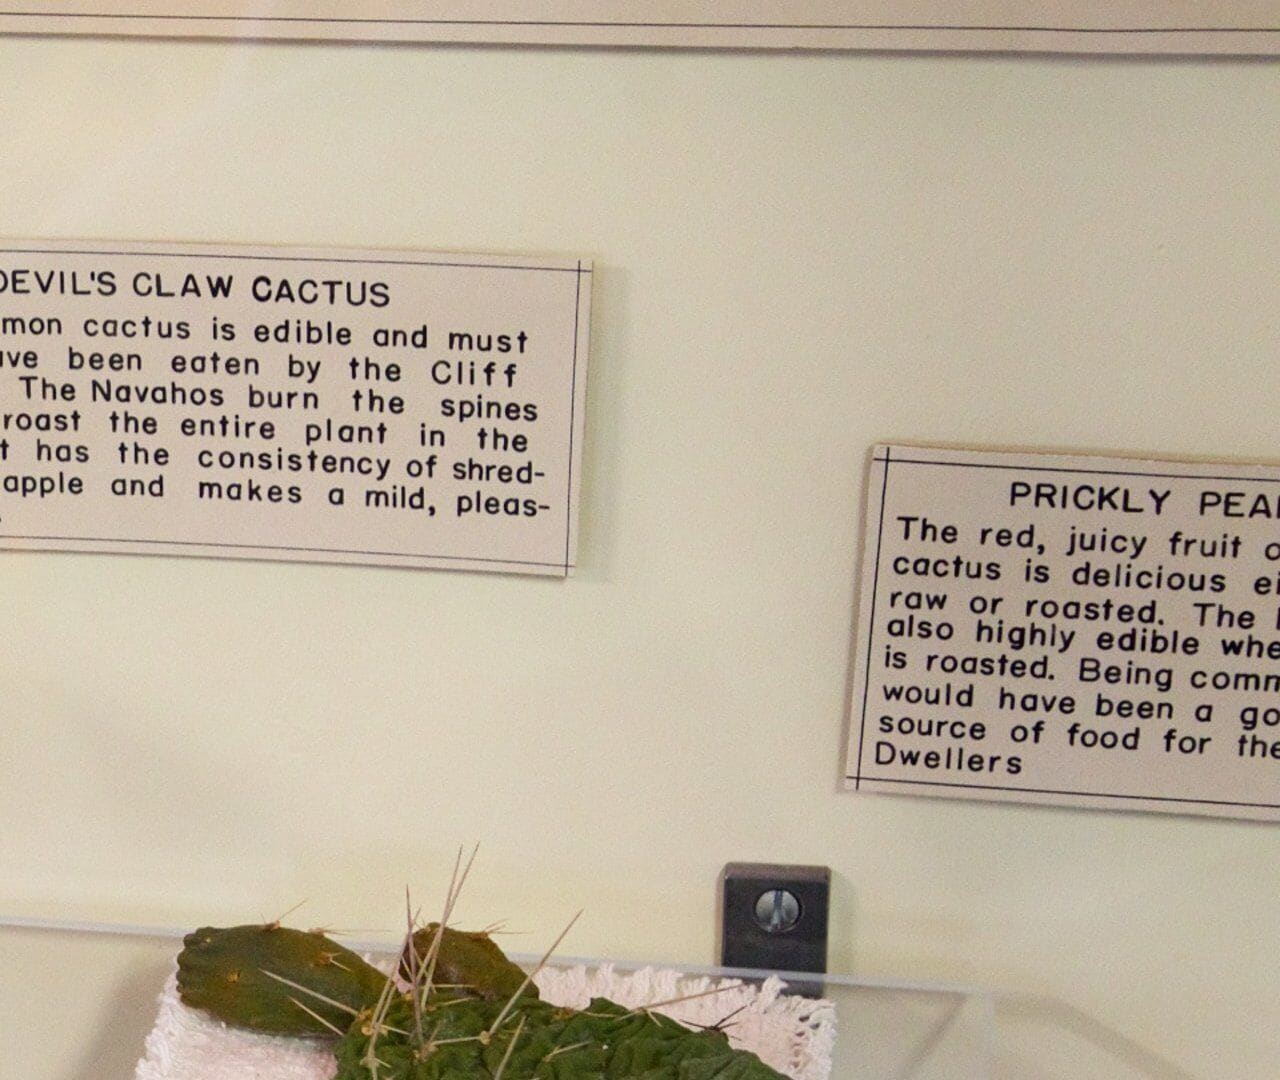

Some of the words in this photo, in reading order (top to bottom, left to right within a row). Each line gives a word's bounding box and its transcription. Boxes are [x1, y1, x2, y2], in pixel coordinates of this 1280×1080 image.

[132, 271, 234, 299] CLAW
[251, 275, 391, 309] CACTUS
[82, 315, 191, 340] cactus
[212, 315, 236, 342] is
[253, 319, 352, 346] edible
[372, 324, 428, 349] and
[448, 330, 529, 354] must
[68, 345, 142, 372] been
[171, 351, 260, 376] eaten
[288, 353, 321, 384] by
[349, 356, 401, 383] the
[430, 359, 517, 389] Cliff
[18, 375, 76, 402] The
[91, 379, 224, 407] Navahos
[248, 384, 319, 410] burn
[352, 388, 405, 415] the
[440, 393, 538, 423] spines
[1009, 481, 1172, 516] PRICKLY
[1199, 490, 1280, 520] PEA
[896, 515, 959, 545] The
[979, 523, 1046, 556] red,
[1065, 525, 1148, 560] juicy
[1168, 530, 1243, 559] fruit
[892, 555, 1001, 581] cactus
[1024, 557, 1050, 584] is
[1071, 561, 1226, 593] delicious
[889, 590, 948, 610] raw
[969, 595, 1004, 615] or
[1025, 598, 1164, 626] roasted.
[1192, 602, 1256, 630] The
[886, 614, 954, 641] also
[975, 619, 1076, 654] highly
[1096, 627, 1200, 656] edible
[884, 644, 907, 670] is
[926, 654, 1055, 681] roasted.
[1078, 657, 1173, 693] Being
[874, 740, 1022, 775] Dwellers
